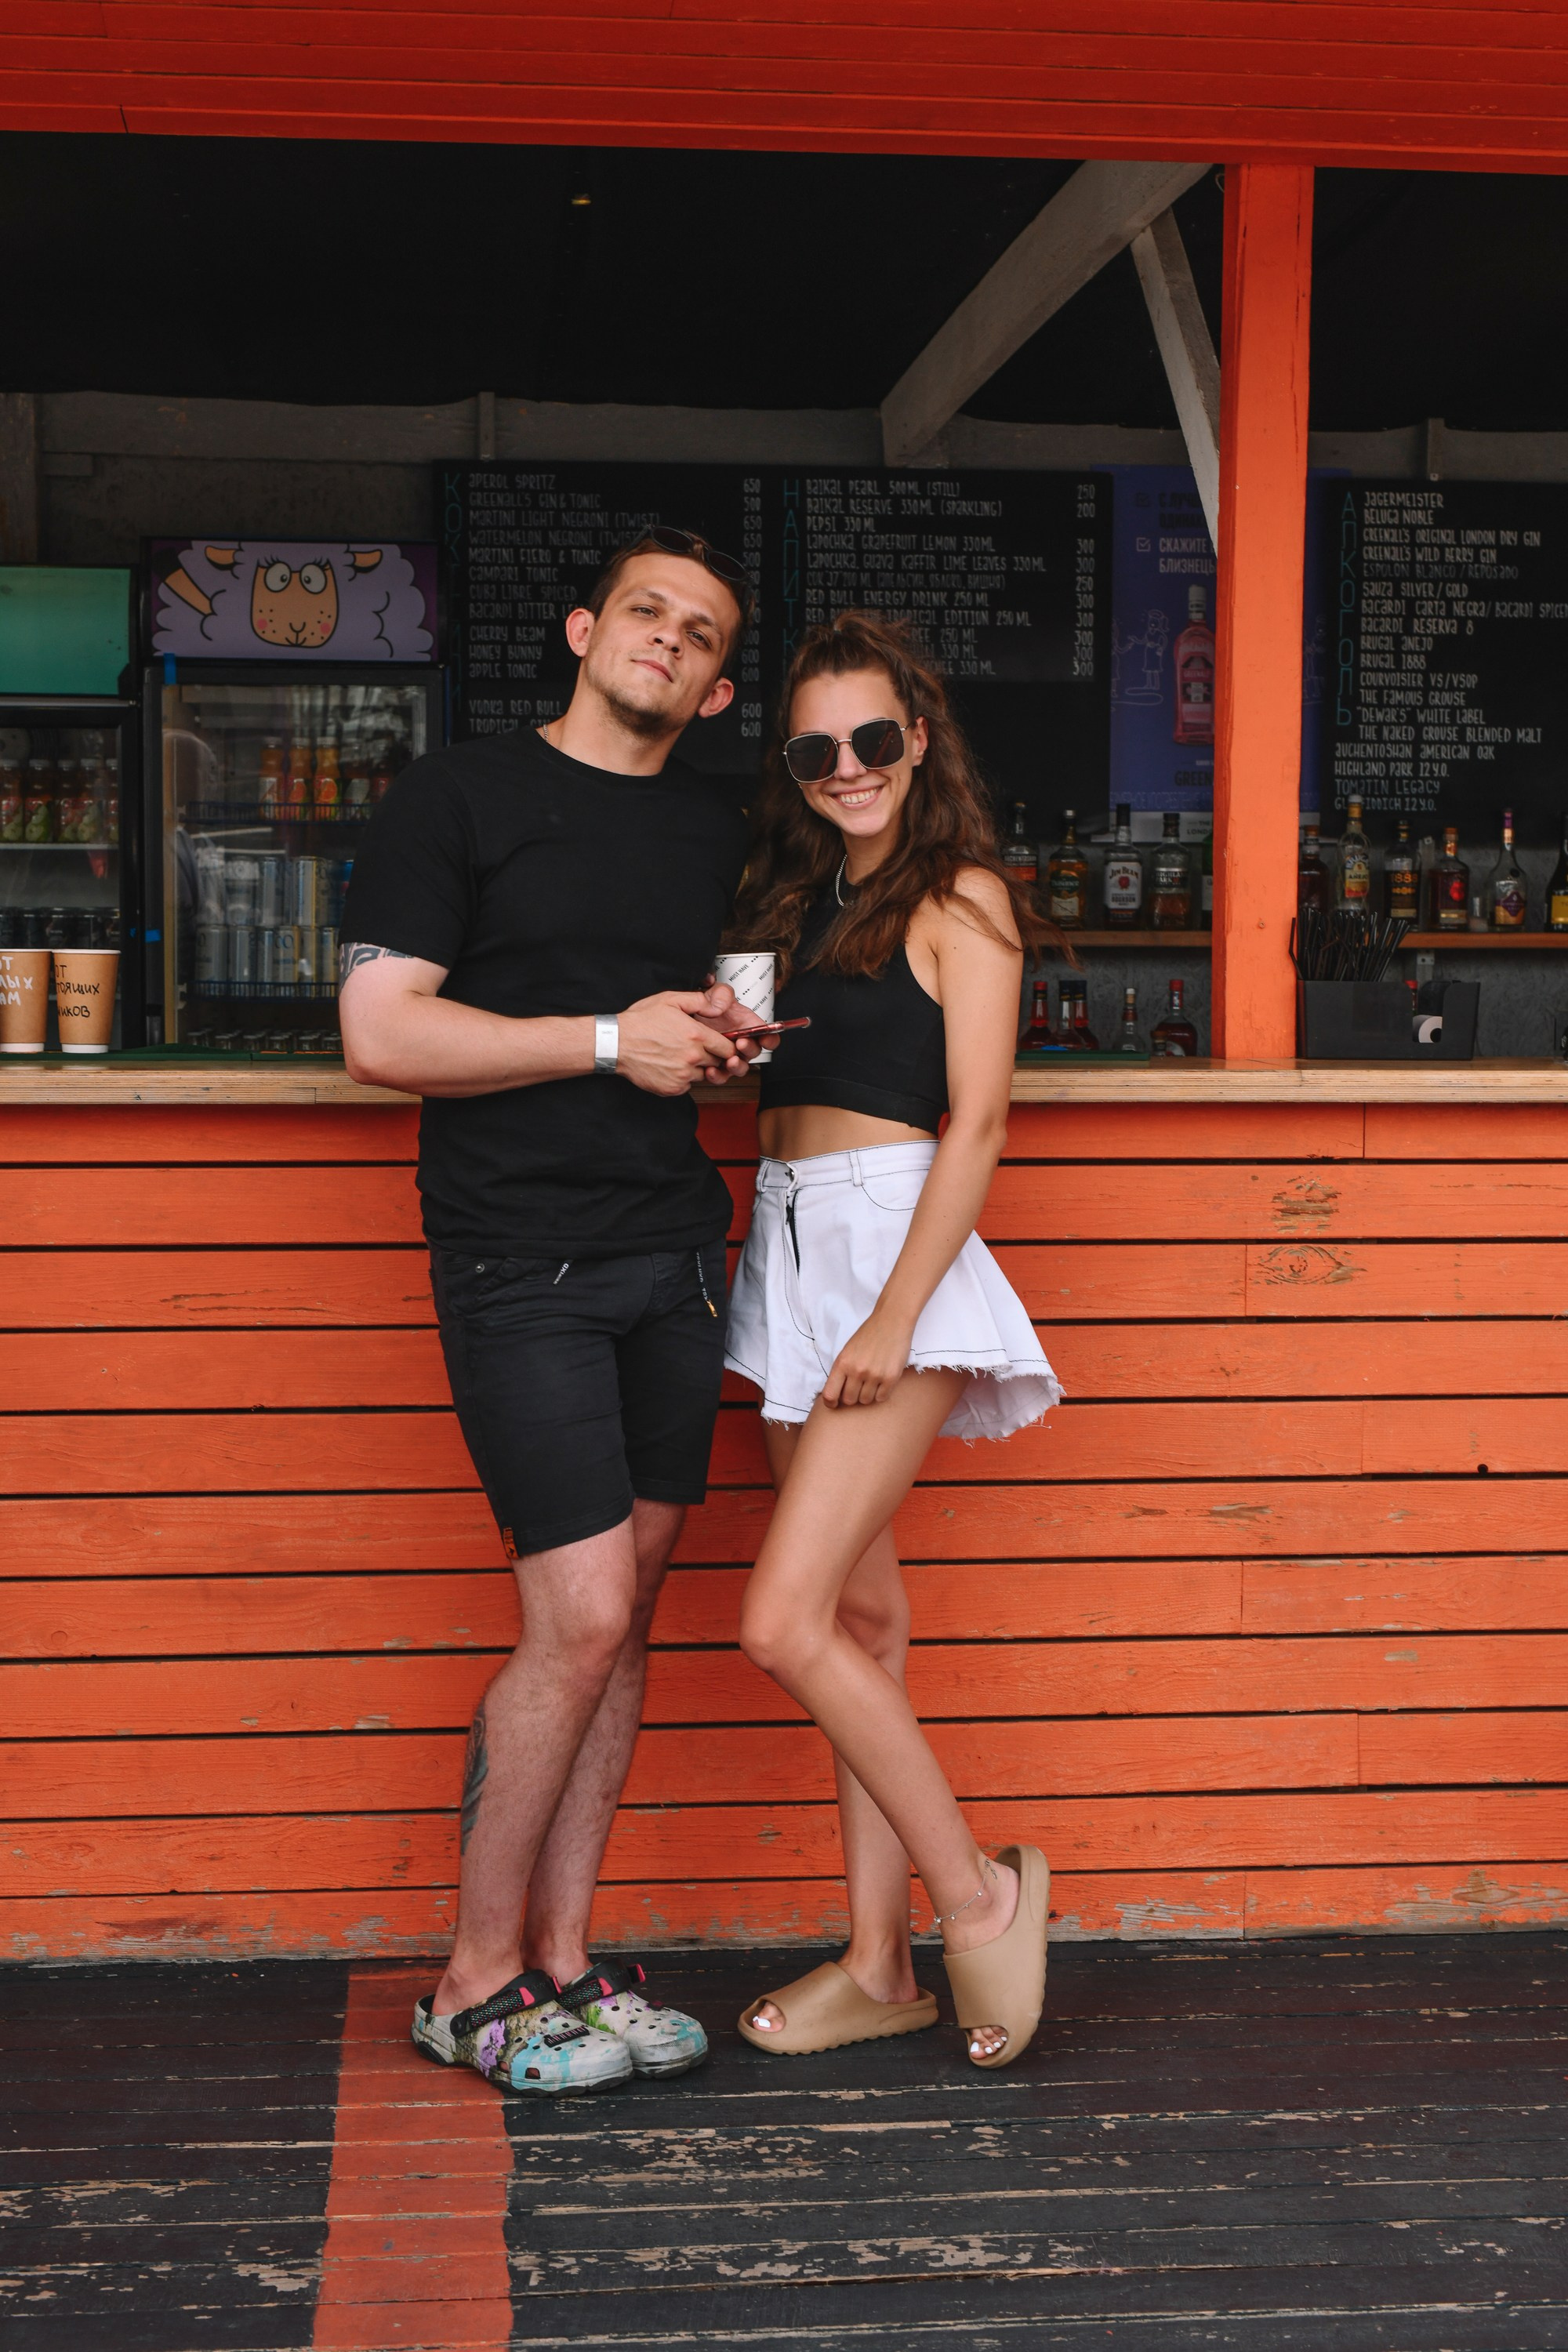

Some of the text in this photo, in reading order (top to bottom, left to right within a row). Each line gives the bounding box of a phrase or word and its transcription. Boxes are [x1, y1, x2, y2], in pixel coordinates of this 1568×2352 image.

[515, 474, 556, 490] SPRITZ
[744, 478, 760, 493] 650
[1076, 485, 1094, 499] 250
[570, 493, 601, 509] TONIC
[744, 497, 760, 511] 500
[850, 499, 893, 514] RESERVE
[1076, 503, 1094, 517] 200
[1403, 510, 1434, 525] NOBLE
[522, 511, 555, 526] LIGHT
[562, 512, 608, 528] NEGRONI
[744, 516, 762, 529] 650
[807, 516, 837, 532] PEPSI
[549, 531, 592, 546] NEGRONI
[744, 533, 762, 547] 650
[923, 535, 956, 550] LEMON
[1160, 538, 1207, 553] СКАЖИТЕ
[1461, 530, 1495, 545] LONDON
[1500, 530, 1518, 546] DRY
[1523, 531, 1541, 546] GIN
[1076, 539, 1094, 554] 300
[520, 550, 551, 564] FIERO
[572, 550, 601, 564] TONIC
[743, 552, 760, 567] 500
[1415, 547, 1439, 562] WILD
[1445, 548, 1473, 563] BERRY
[1480, 549, 1497, 563] GIN
[943, 555, 967, 571] LIME
[1076, 557, 1094, 572] 300
[526, 567, 558, 582] TONIC
[1076, 575, 1094, 591] 250
[805, 589, 825, 604] RED
[829, 590, 855, 605] BULL
[864, 590, 906, 605] ENERGY
[912, 591, 947, 606] DRINK
[1076, 593, 1094, 608] 300
[518, 603, 557, 619] BITTER
[805, 608, 825, 622] RED
[944, 610, 989, 626] EDITION
[1076, 612, 1094, 626] 300
[1466, 620, 1474, 635] 8
[940, 628, 978, 643] 250 ML
[1074, 630, 1093, 645] 300
[470, 644, 543, 659] HONEY BUNNY
[742, 649, 759, 663] 600
[963, 644, 978, 659] ML
[1073, 660, 1094, 676] 300
[1402, 655, 1427, 670] 1888
[506, 663, 537, 678] TONIC
[742, 666, 759, 681] 600
[1360, 672, 1424, 688] COURVOISIER
[1359, 688, 1377, 703] THE
[1428, 691, 1466, 706] GROUSE
[511, 700, 532, 714] RED
[742, 703, 761, 717] 600
[1417, 708, 1450, 724] WHITE
[741, 722, 760, 736] 600
[1359, 724, 1377, 740] THE
[1422, 726, 1458, 742] GROUSE
[1466, 727, 1511, 742] BLENDED
[1419, 762, 1429, 776] 12
[1109, 866, 1139, 880] JIM BEAM
[728, 964, 750, 982] MUST HAVE
[759, 971, 768, 981] MUST
[759, 995, 768, 1005] HAVE
